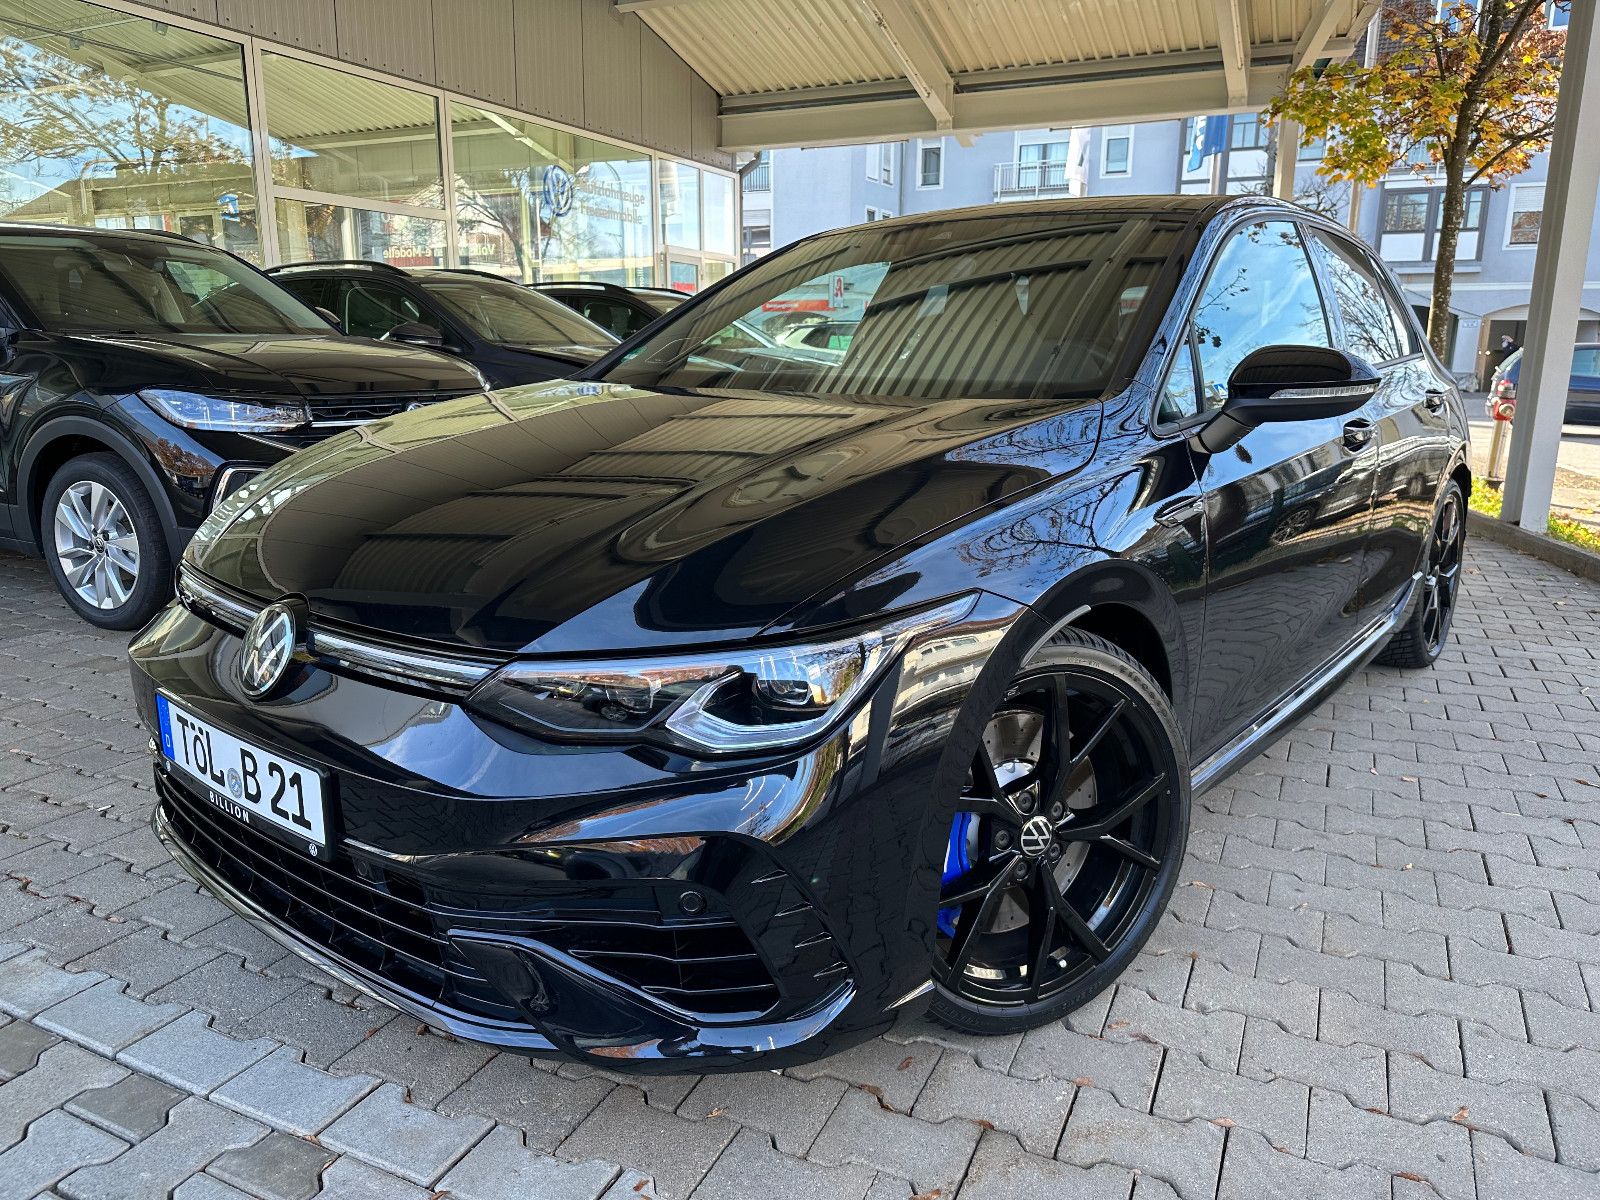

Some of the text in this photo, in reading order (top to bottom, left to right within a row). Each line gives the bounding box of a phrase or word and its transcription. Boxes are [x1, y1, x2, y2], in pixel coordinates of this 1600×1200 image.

[176, 713, 225, 788] TÖL
[240, 747, 262, 804] B
[268, 761, 312, 830] 21
[209, 791, 250, 823] BILLION
